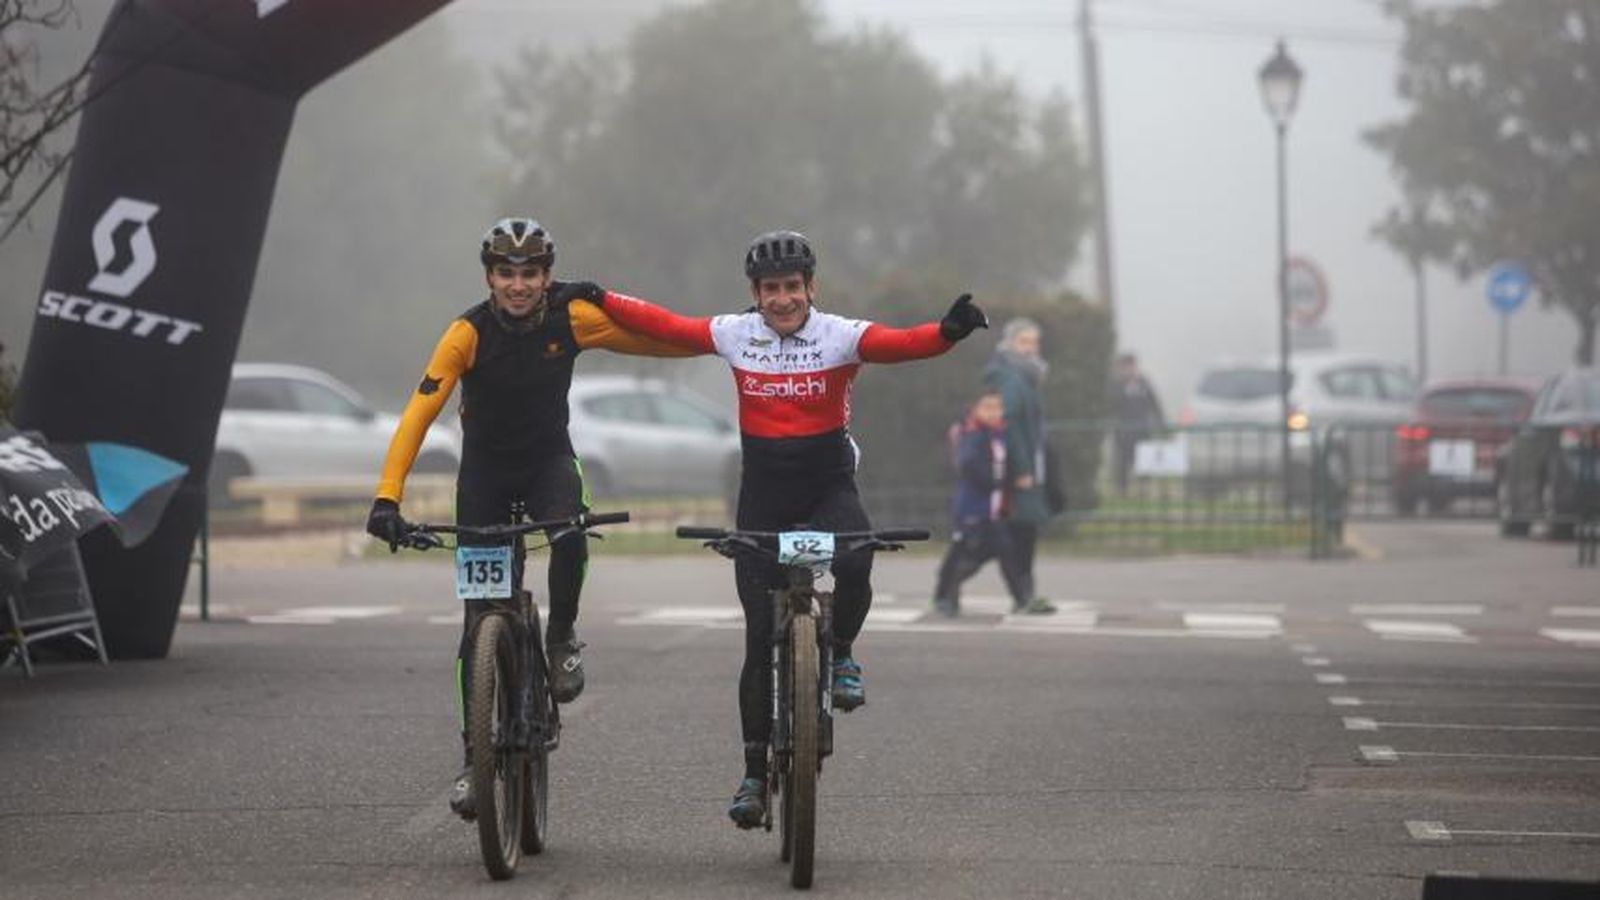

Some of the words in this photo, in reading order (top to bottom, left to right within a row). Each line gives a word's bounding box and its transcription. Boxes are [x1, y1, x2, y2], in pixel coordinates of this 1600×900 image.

[38, 290, 203, 345] SCOTT
[742, 351, 821, 362] MATRIX
[464, 560, 504, 584] 135
